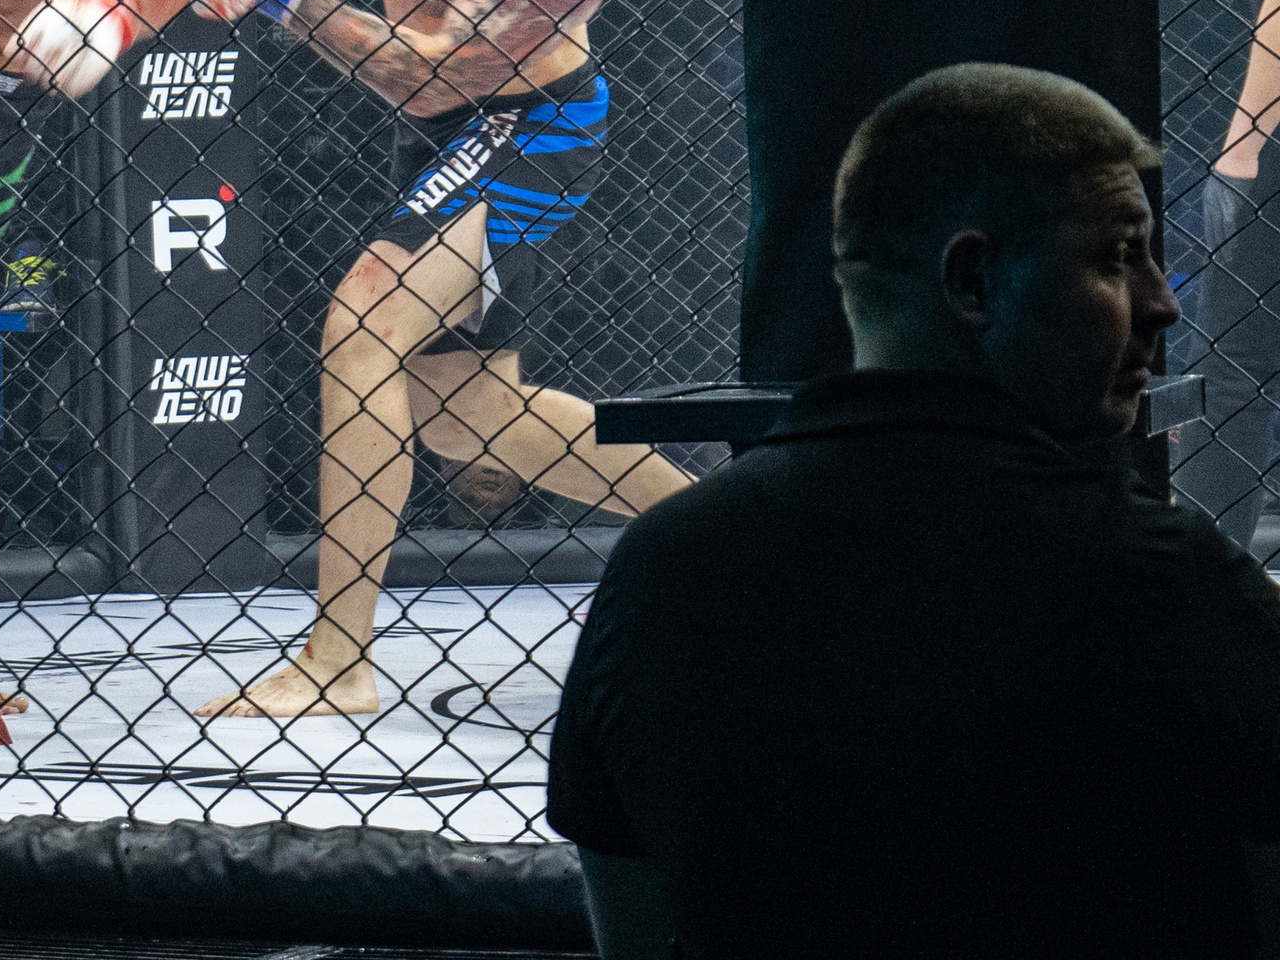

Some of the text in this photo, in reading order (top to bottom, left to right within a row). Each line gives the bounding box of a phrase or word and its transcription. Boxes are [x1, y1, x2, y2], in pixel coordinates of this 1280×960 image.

[140, 51, 239, 85] НАШЕ
[142, 85, 232, 120] ДЕЛО
[407, 137, 493, 215] НАШЕ
[151, 354, 250, 390] НАШЕ
[153, 389, 244, 424] ДЕЛО
